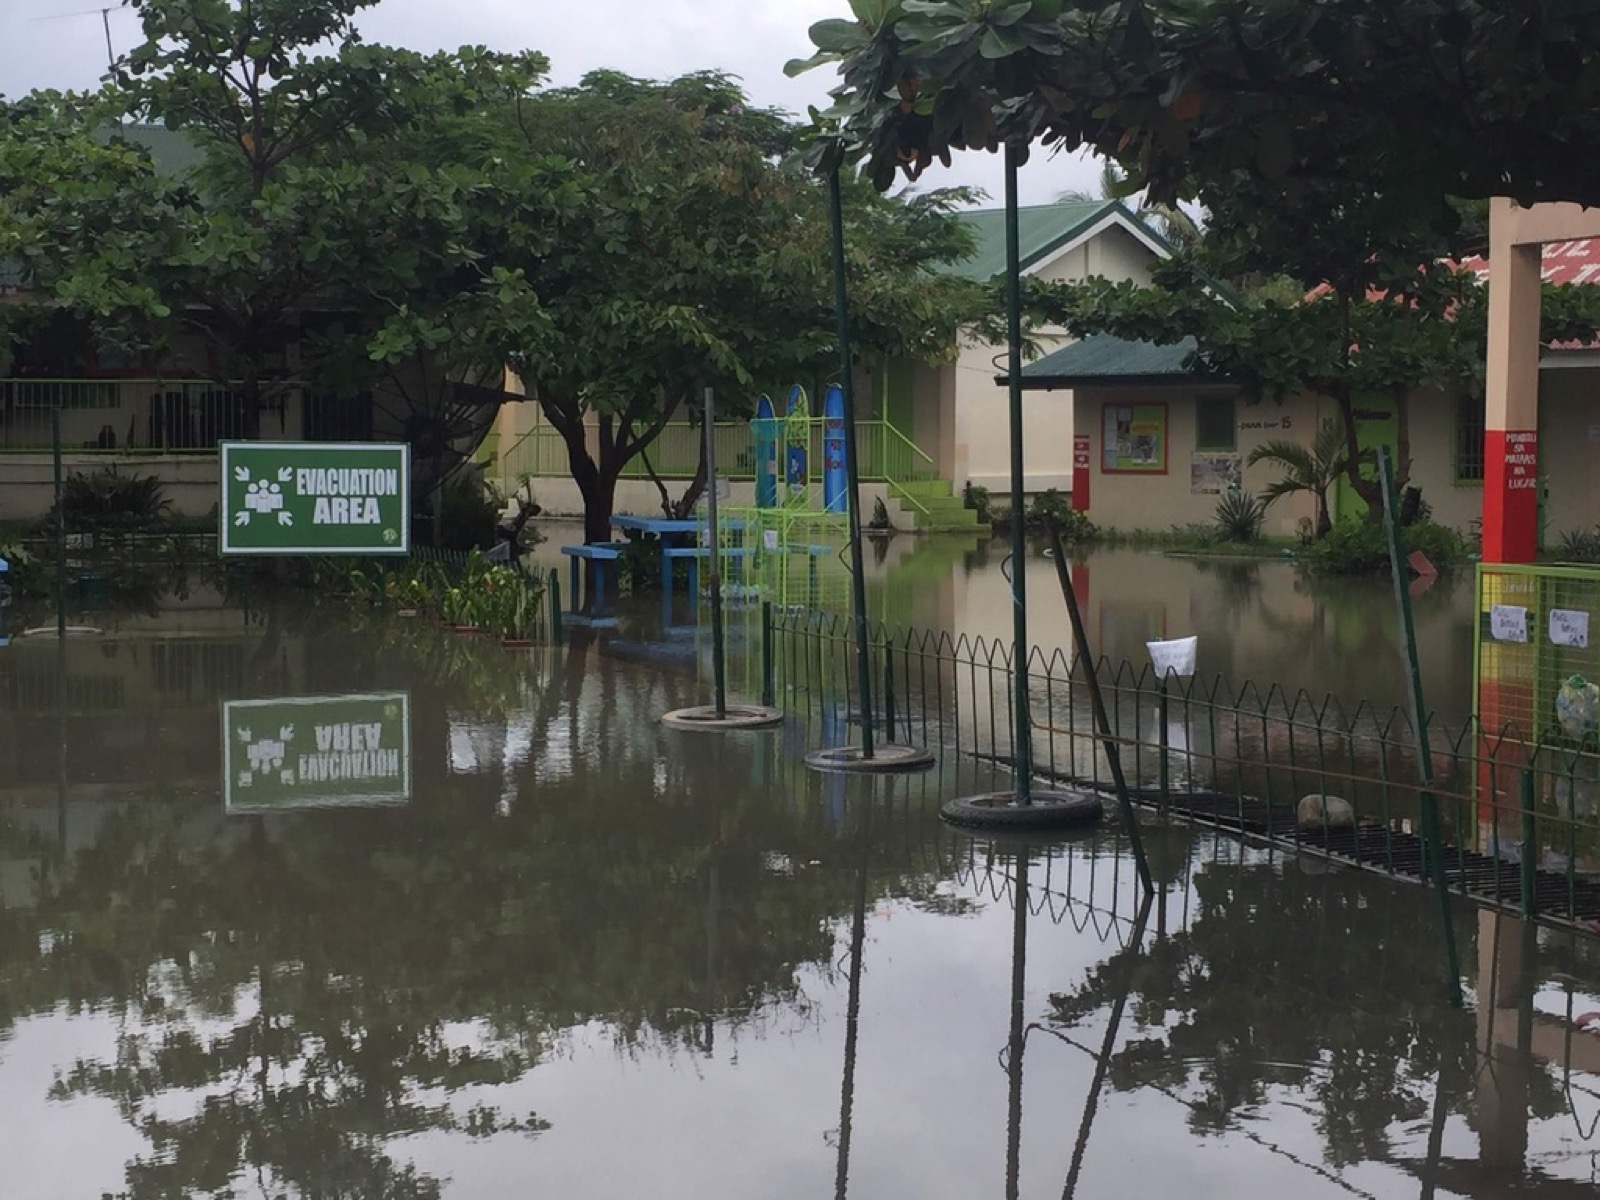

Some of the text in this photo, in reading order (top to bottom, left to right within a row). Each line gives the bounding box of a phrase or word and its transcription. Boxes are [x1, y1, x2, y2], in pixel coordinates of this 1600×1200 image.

[296, 468, 398, 496] EVACUATION
[1508, 477, 1537, 489] LUGAR
[313, 497, 381, 524] AREA
